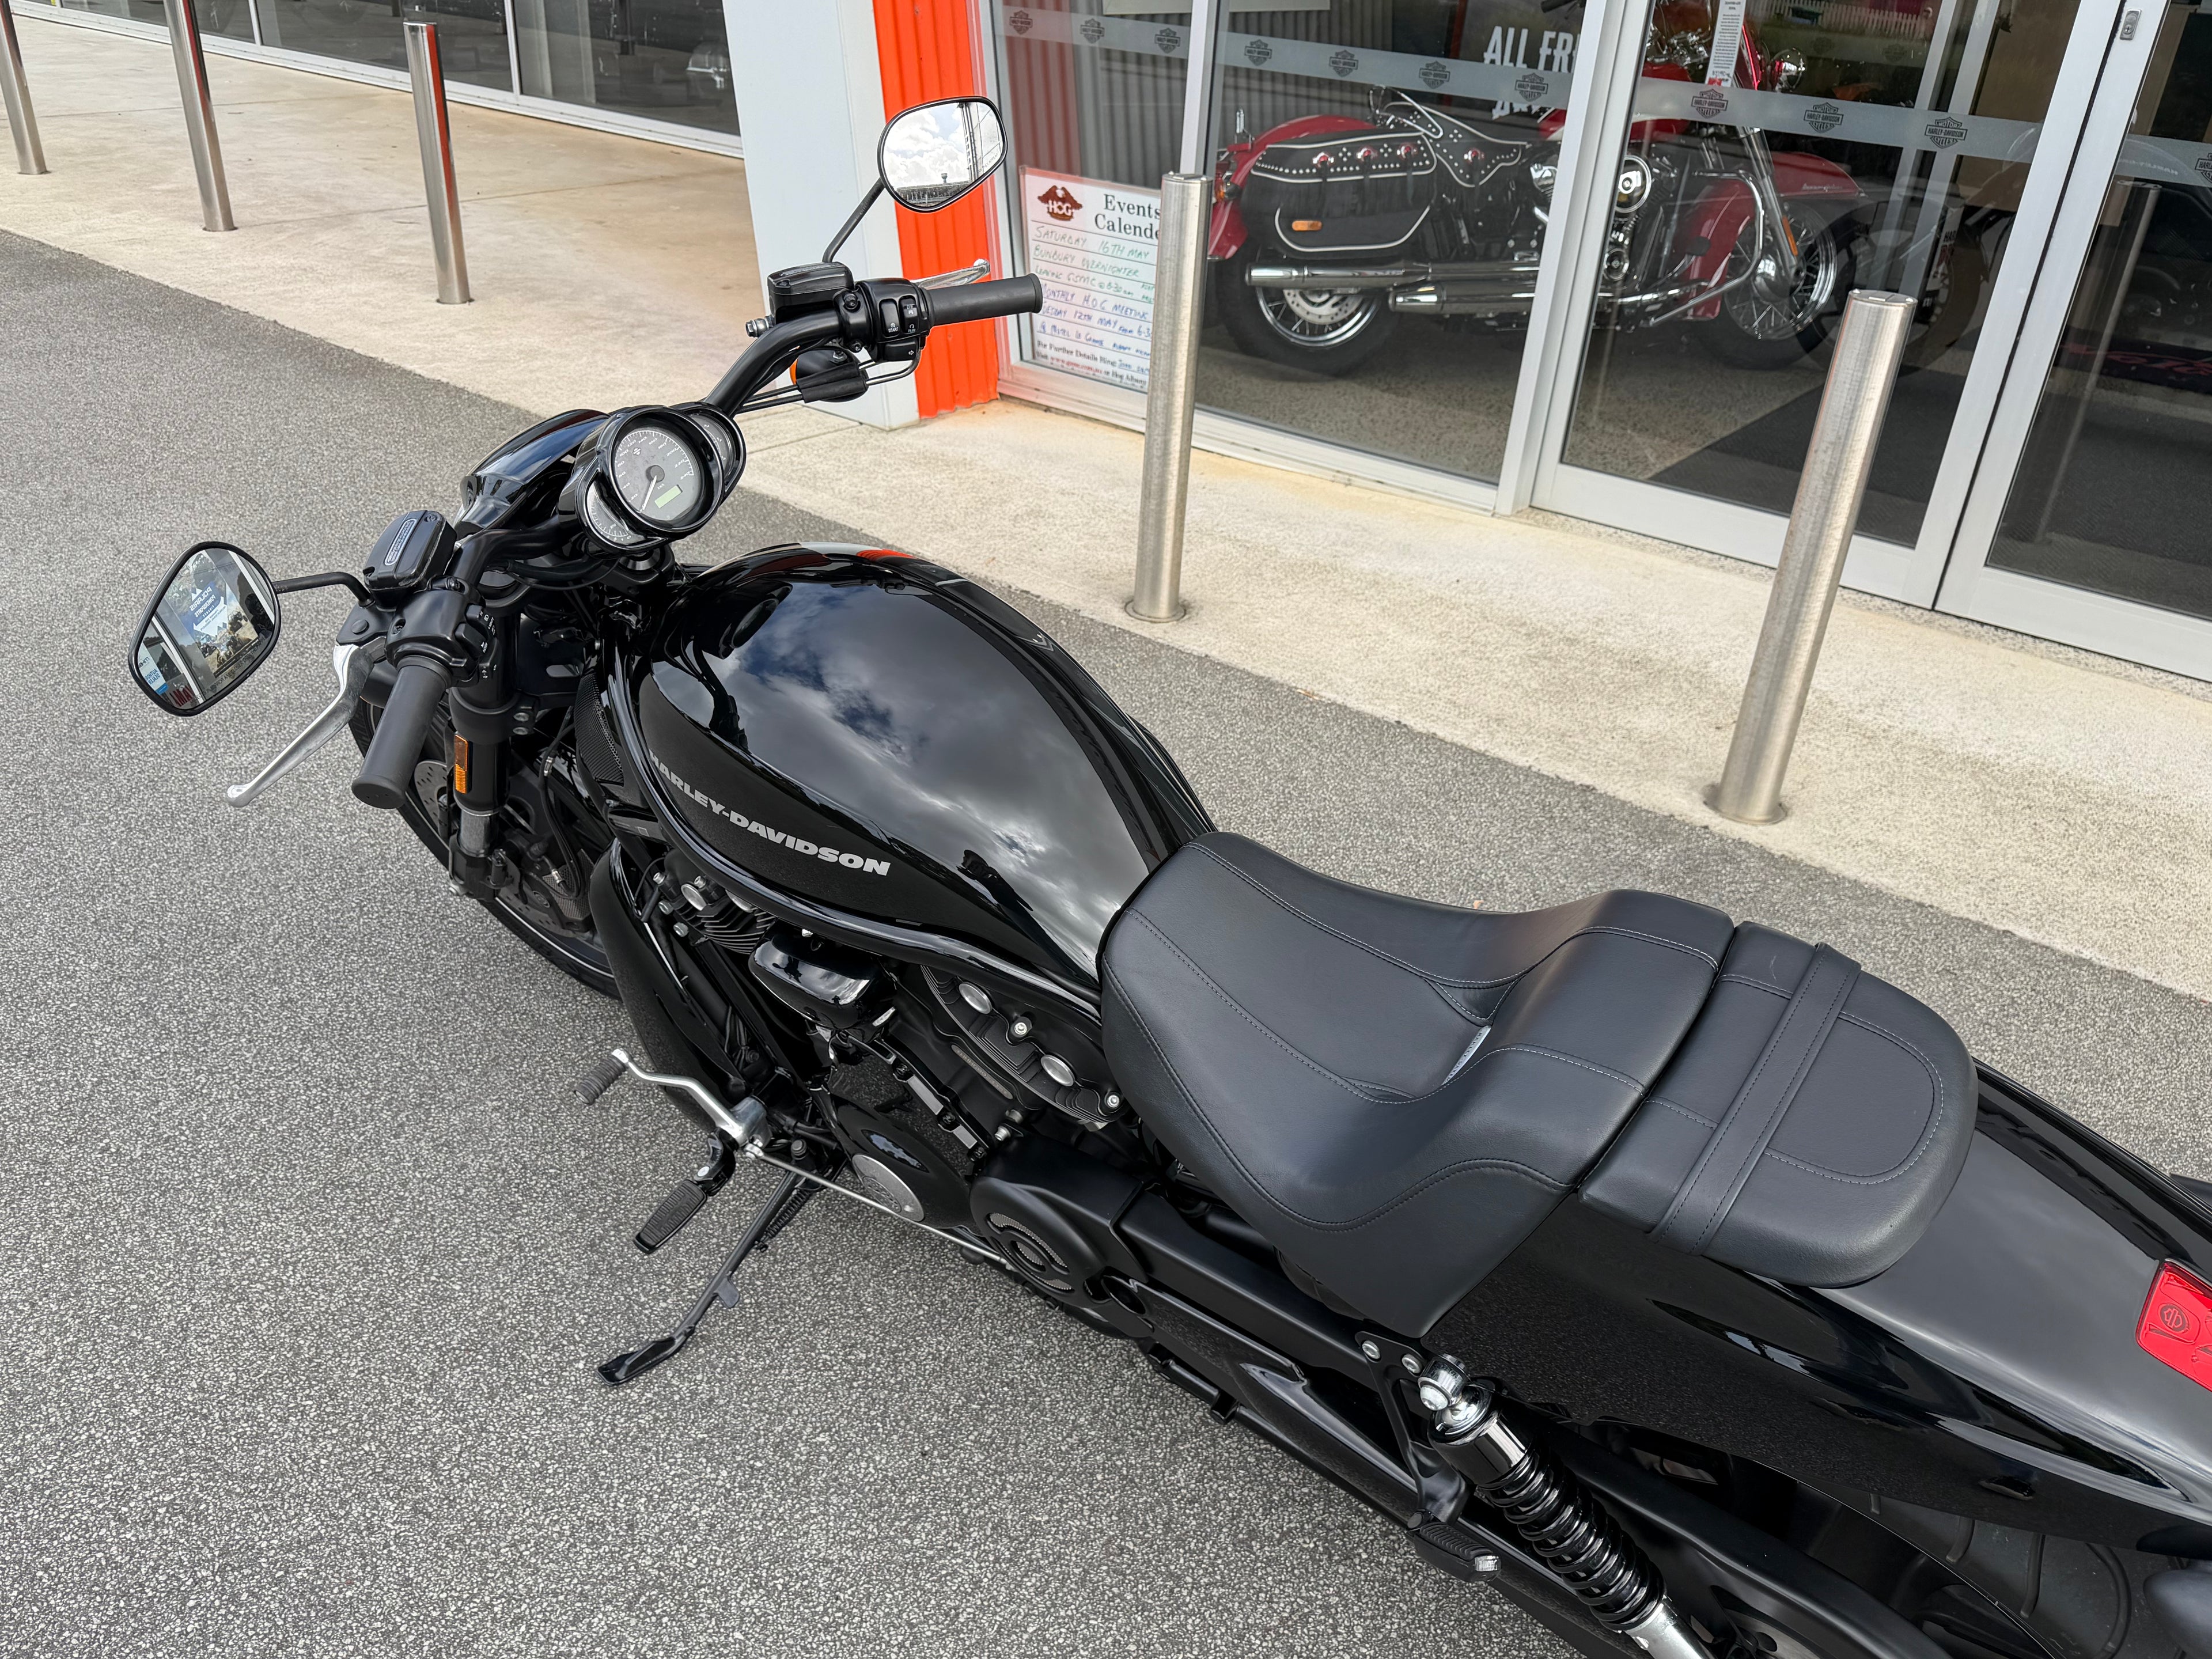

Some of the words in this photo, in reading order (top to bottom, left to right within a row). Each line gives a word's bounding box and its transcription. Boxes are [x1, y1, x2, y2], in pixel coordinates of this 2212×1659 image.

[1483, 25, 1528, 69] ALL
[1104, 194, 1161, 220] Events
[1094, 213, 1160, 240] Calende
[647, 749, 891, 877] HARLEY-DAVIDSON
